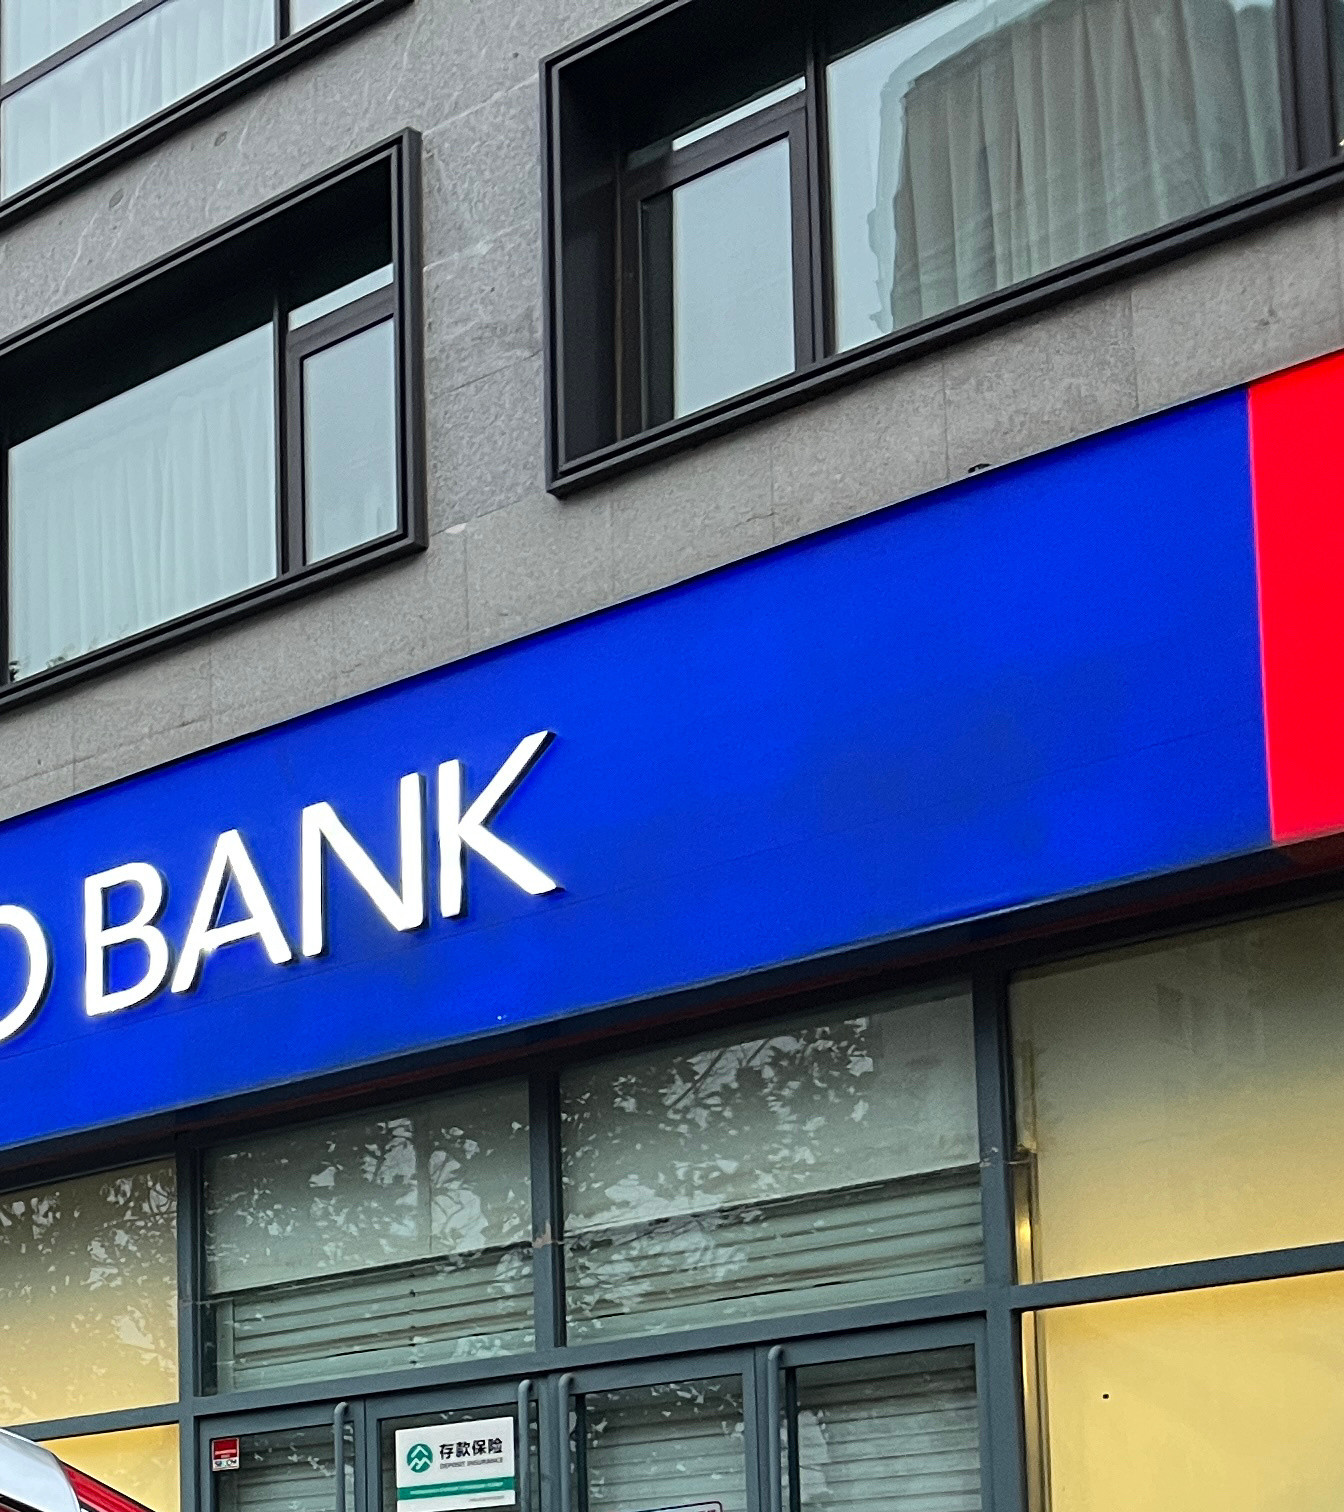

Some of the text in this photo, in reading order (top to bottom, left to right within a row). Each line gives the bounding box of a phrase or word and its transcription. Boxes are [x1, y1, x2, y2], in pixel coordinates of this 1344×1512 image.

[84, 729, 560, 1017] BANK
[438, 1437, 503, 1460] 存款保险
